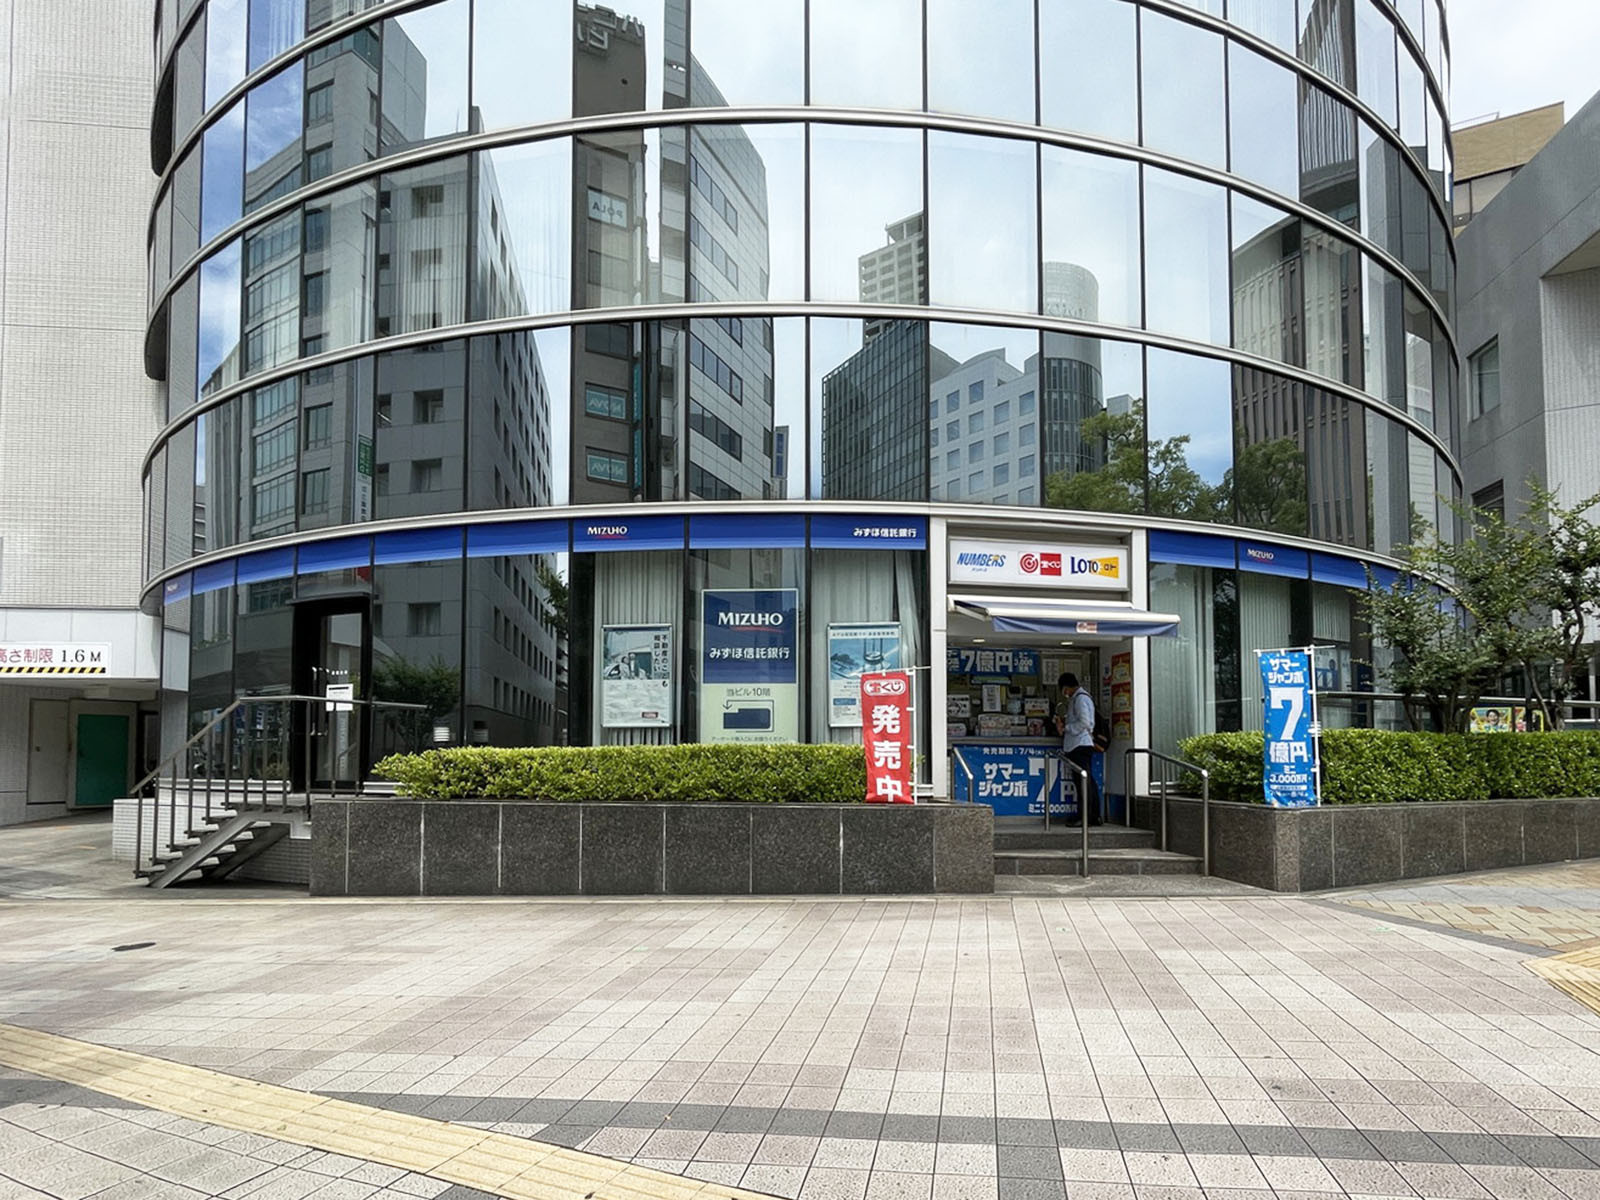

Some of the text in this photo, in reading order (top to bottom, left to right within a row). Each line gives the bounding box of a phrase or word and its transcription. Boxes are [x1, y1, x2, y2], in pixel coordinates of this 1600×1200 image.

[587, 526, 628, 536] MIZUHO
[853, 527, 917, 538] みずほ信託銀行
[956, 553, 1006, 567] NUMBERS
[1247, 549, 1274, 560] MIZUHO
[1071, 556, 1099, 574] LOTO
[718, 612, 784, 626] MIZUHO
[61, 649, 86, 664] 1.6
[90, 651, 102, 663] M
[709, 647, 790, 660] みずほ信託銀行
[960, 650, 1014, 673] 7億円
[1269, 659, 1300, 671] サマー
[1268, 672, 1304, 684] ジャンボ
[727, 687, 771, 697] 当ビル10階
[1269, 687, 1304, 740] 7
[872, 704, 903, 803] 発売中
[1269, 741, 1309, 764] 億円
[983, 763, 1025, 780] サマー
[1284, 765, 1296, 774] ミニ
[1028, 757, 1059, 803] 7
[978, 781, 1028, 798] ジャンボ
